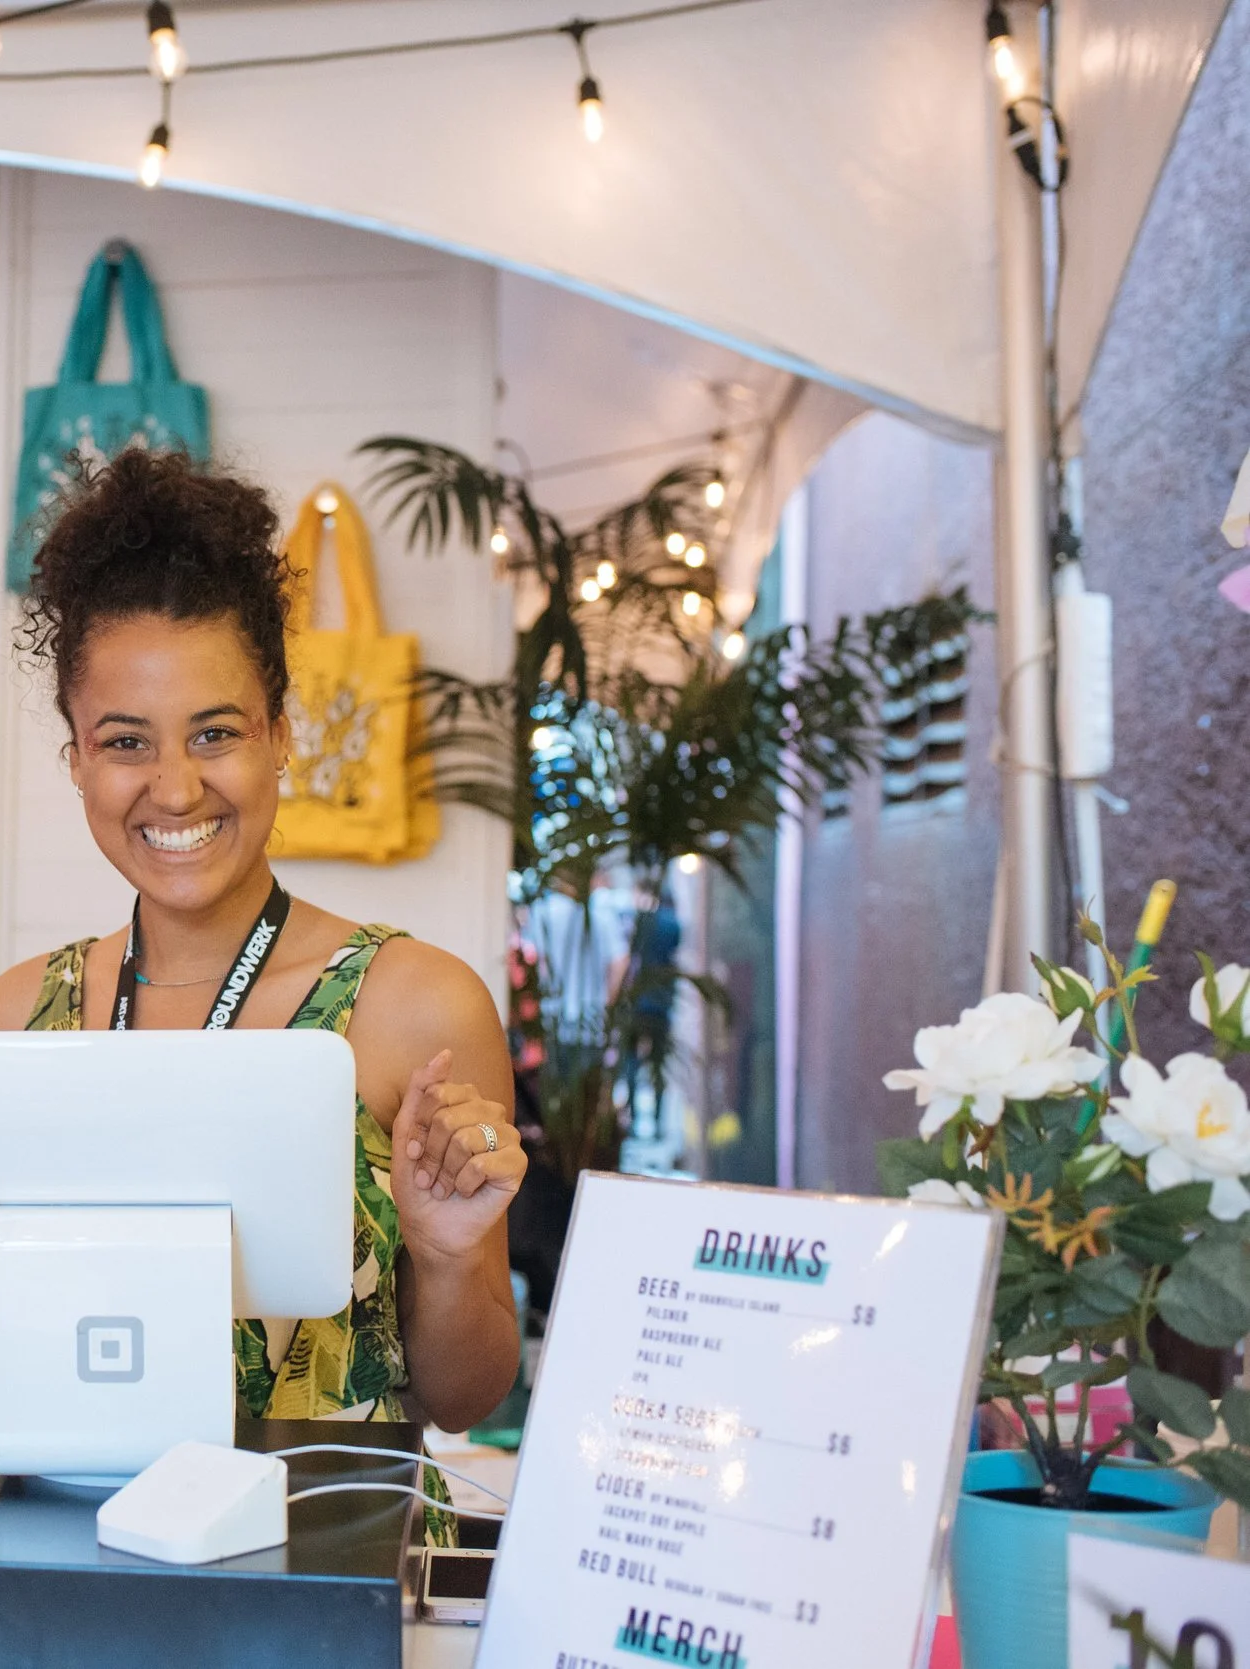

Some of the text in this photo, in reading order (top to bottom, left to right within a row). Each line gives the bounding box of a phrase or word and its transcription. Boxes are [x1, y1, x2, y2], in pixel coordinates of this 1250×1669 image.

[699, 1228, 827, 1278] DRINKS
[638, 1276, 680, 1299] BEER
[748, 1299, 781, 1313] ISLAND
[852, 1304, 877, 1326] $8
[646, 1306, 689, 1323] PILSNER
[641, 1328, 723, 1351] RASPBERRY ALE
[636, 1349, 684, 1368] PALE ALE
[631, 1371, 649, 1384] IPA
[595, 1473, 646, 1499] CIDER
[603, 1503, 706, 1538] JACKPOT DRY APPLE
[625, 1531, 654, 1548] MARY
[578, 1549, 611, 1574] RED
[617, 1557, 657, 1587] BULL
[622, 1605, 744, 1669] MERCH
